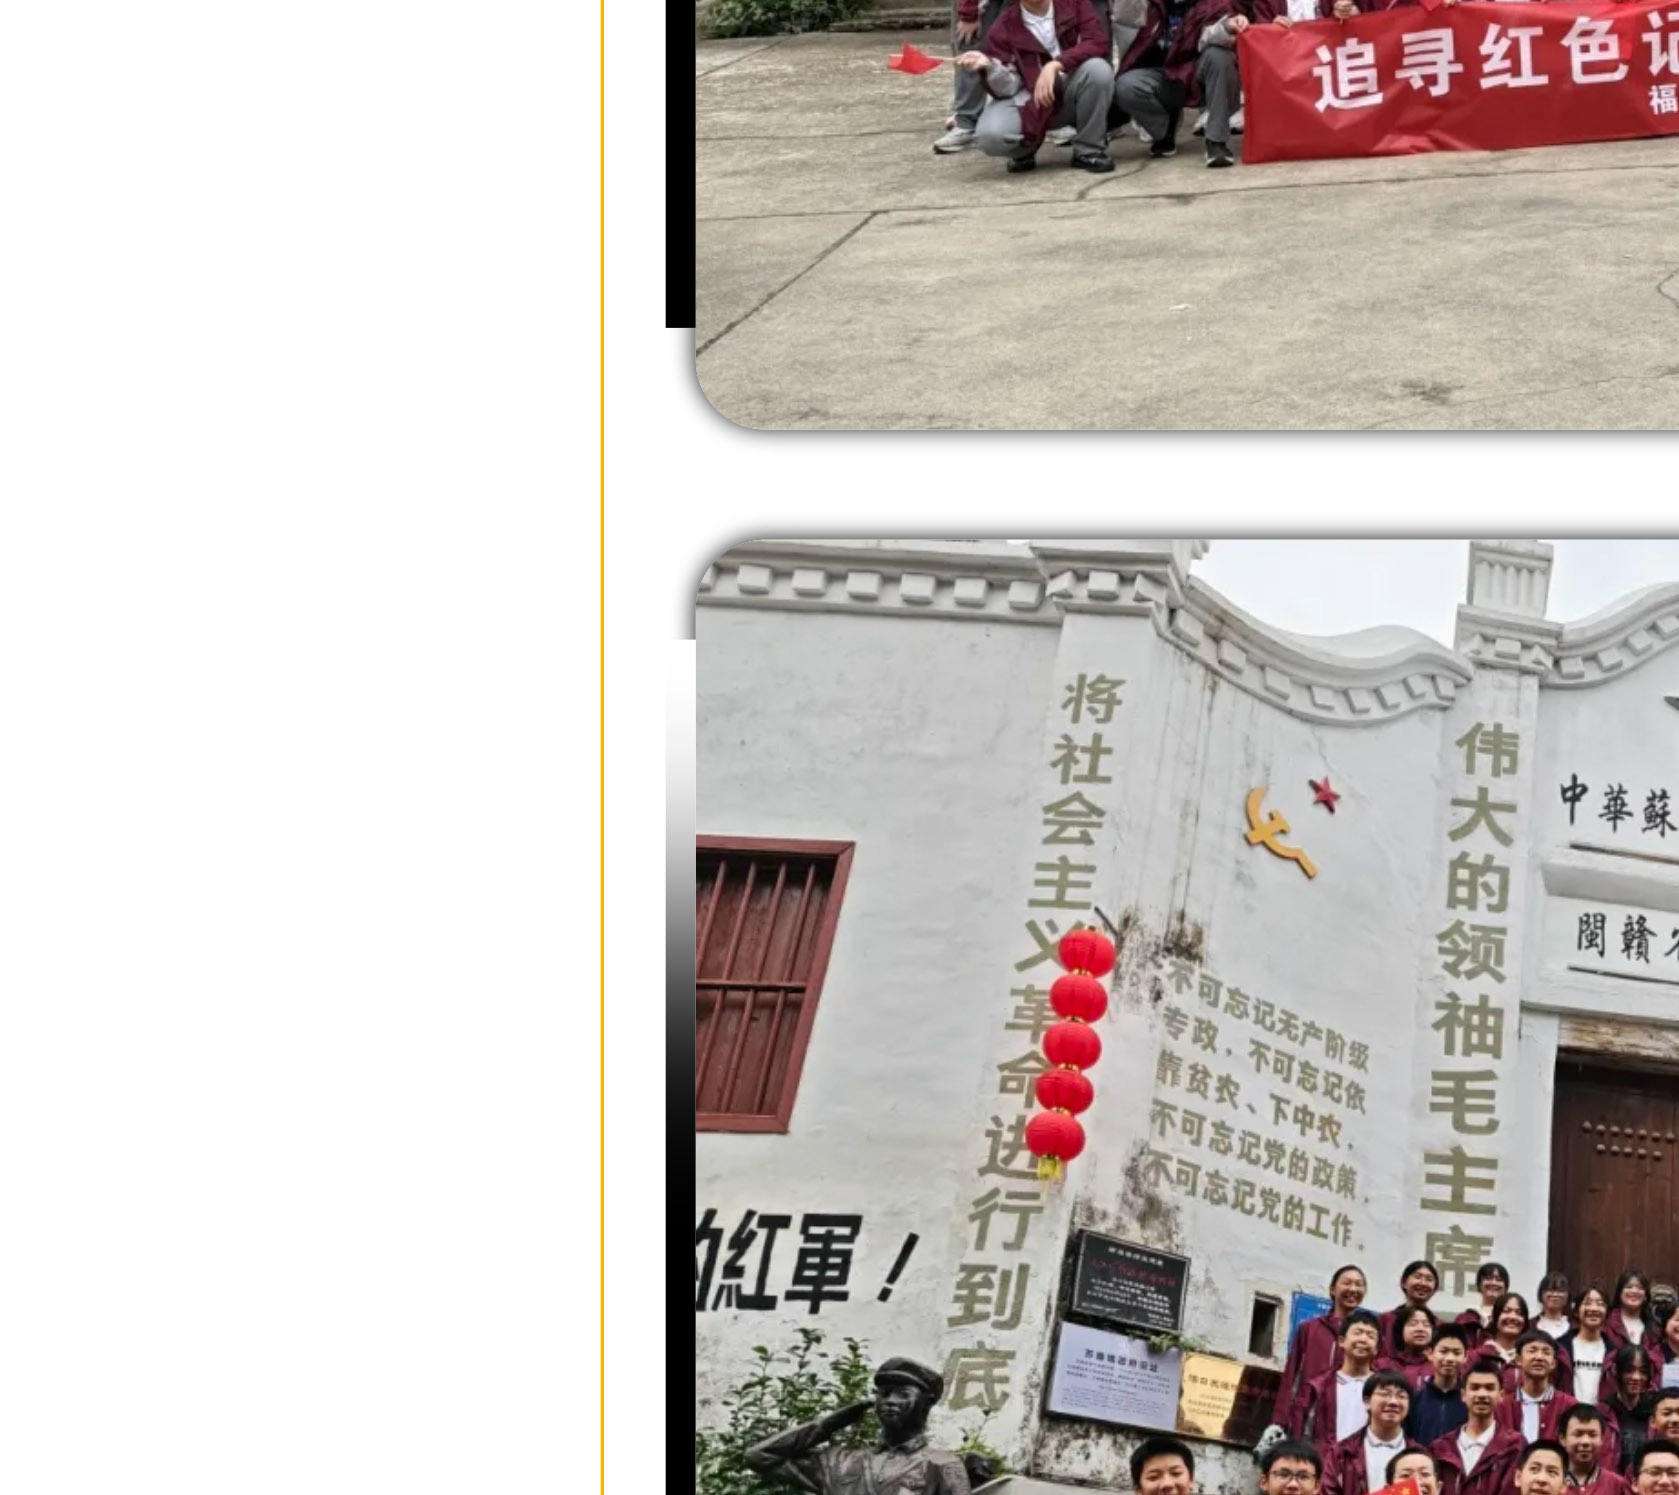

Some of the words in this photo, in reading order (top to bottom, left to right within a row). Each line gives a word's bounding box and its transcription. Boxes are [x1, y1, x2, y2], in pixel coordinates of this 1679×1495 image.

[1167, 958, 1371, 1074] 不可忘记无产阶级
[1420, 721, 1520, 1321] 伟大的领袖毛主席
